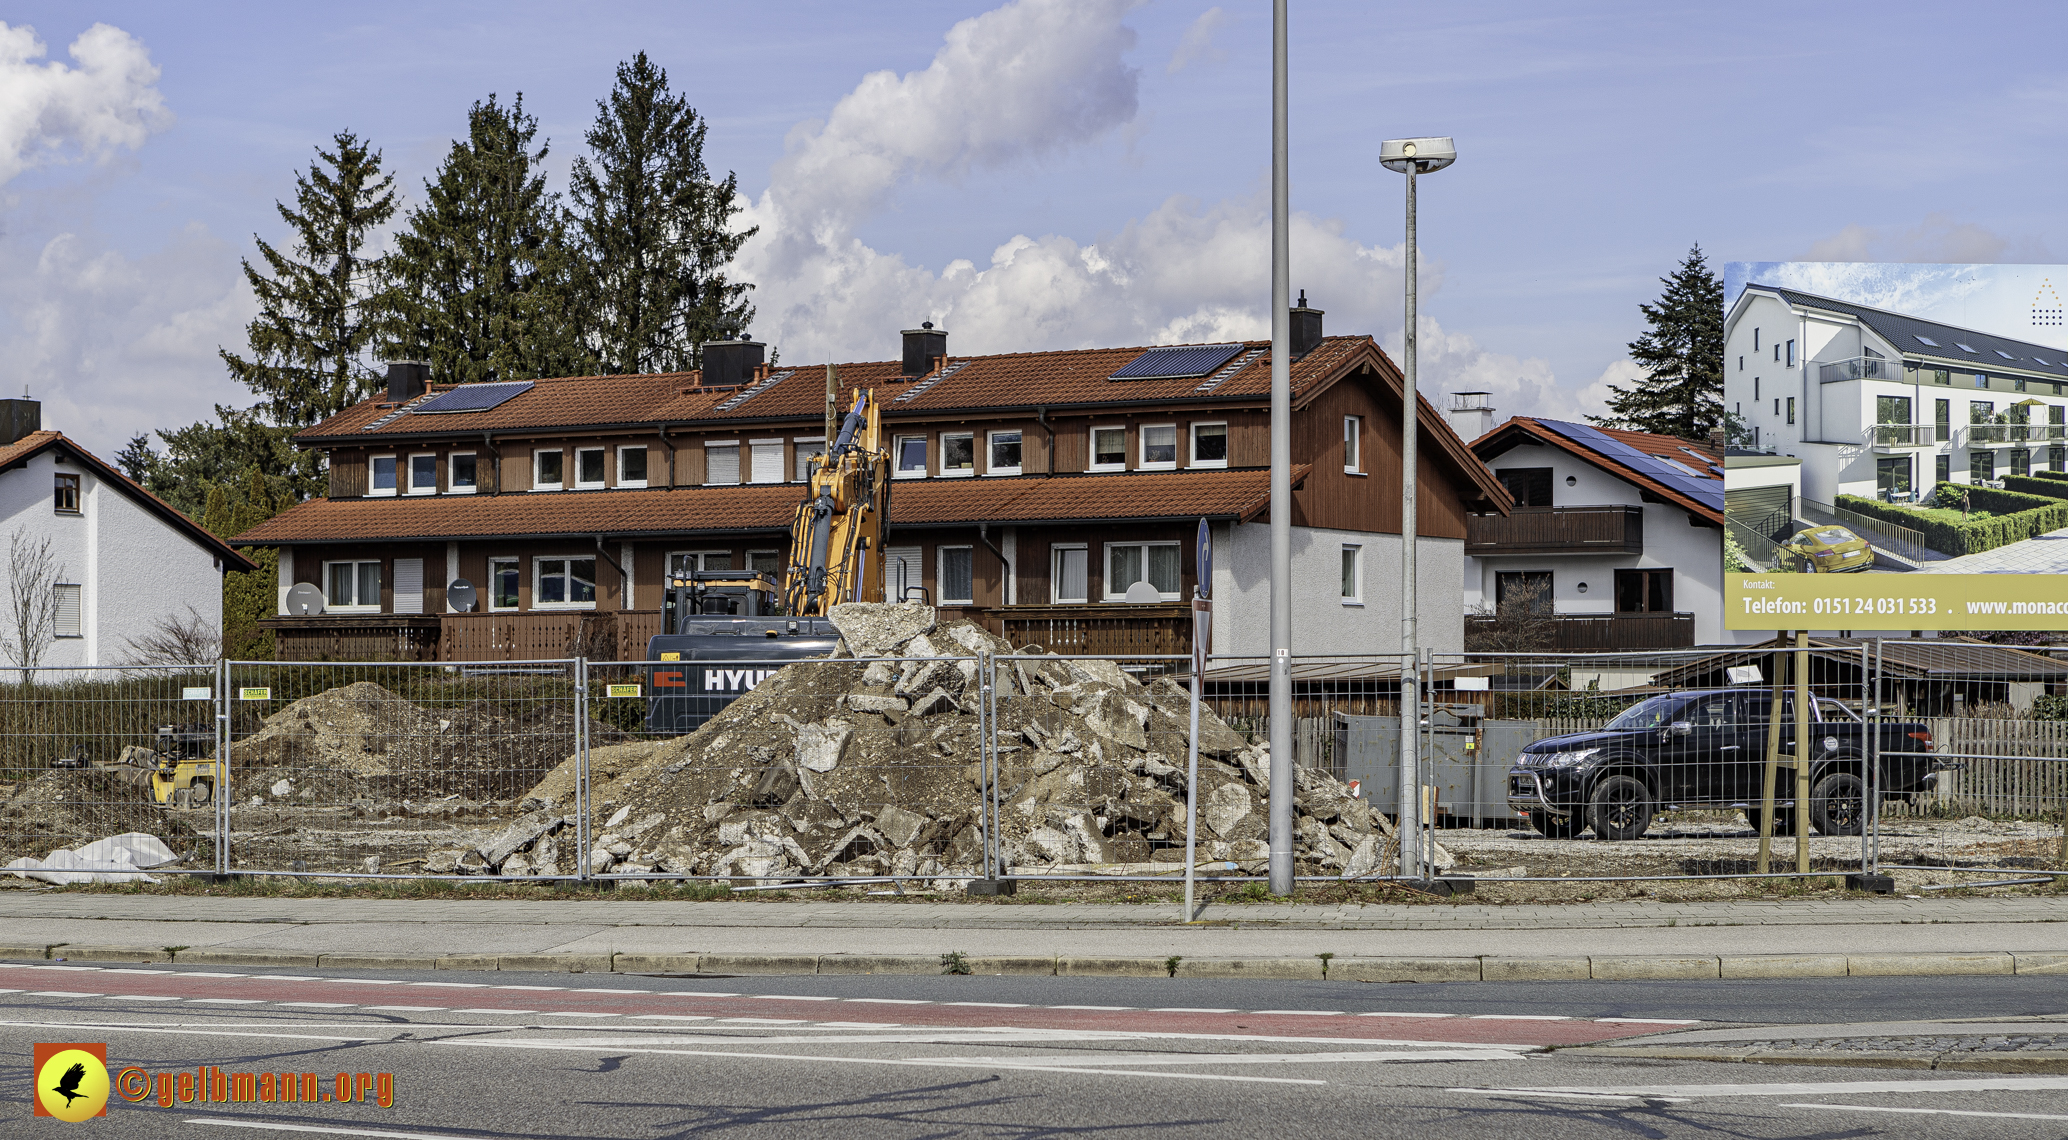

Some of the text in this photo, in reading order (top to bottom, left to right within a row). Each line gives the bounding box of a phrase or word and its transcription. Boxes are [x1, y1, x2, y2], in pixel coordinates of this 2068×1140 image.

[1743, 579, 1775, 589] Kontakt:
[1743, 597, 1806, 614] Telefon:
[1813, 597, 1851, 614] 0151
[1855, 597, 1874, 614] 24
[1877, 597, 1904, 614] 031
[1909, 597, 1937, 614] 533
